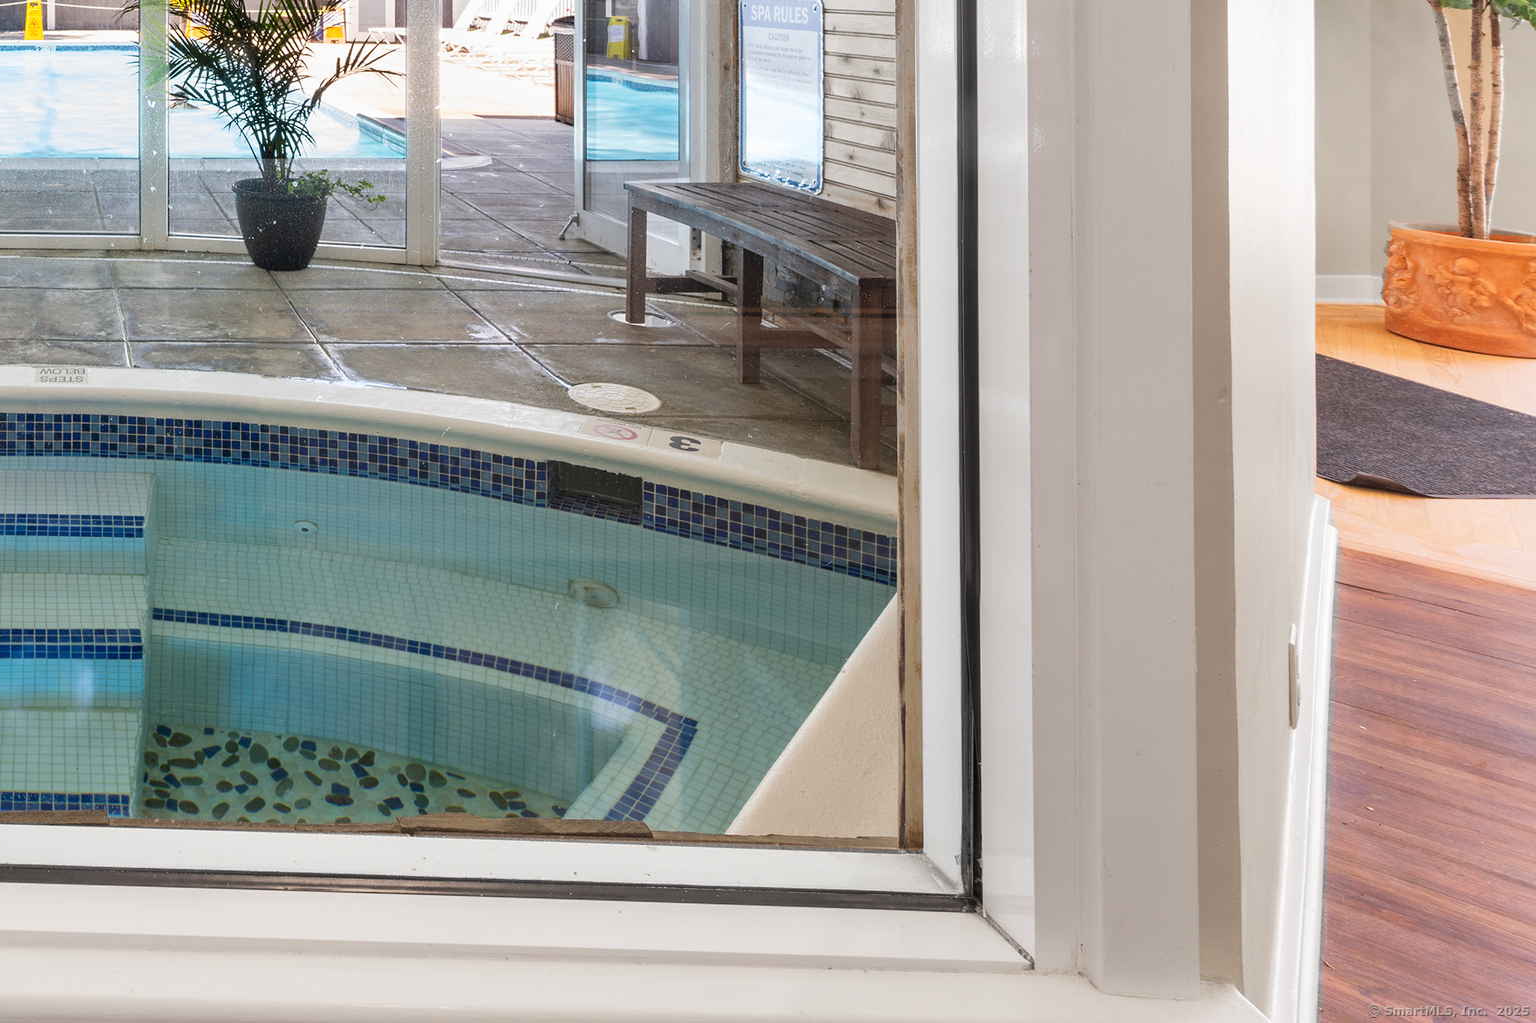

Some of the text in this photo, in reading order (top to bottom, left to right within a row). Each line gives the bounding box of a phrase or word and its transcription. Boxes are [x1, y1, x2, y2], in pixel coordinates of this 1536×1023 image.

[750, 4, 809, 25] SPA RULES
[768, 32, 790, 42] CAUTION
[668, 435, 702, 452] 3
